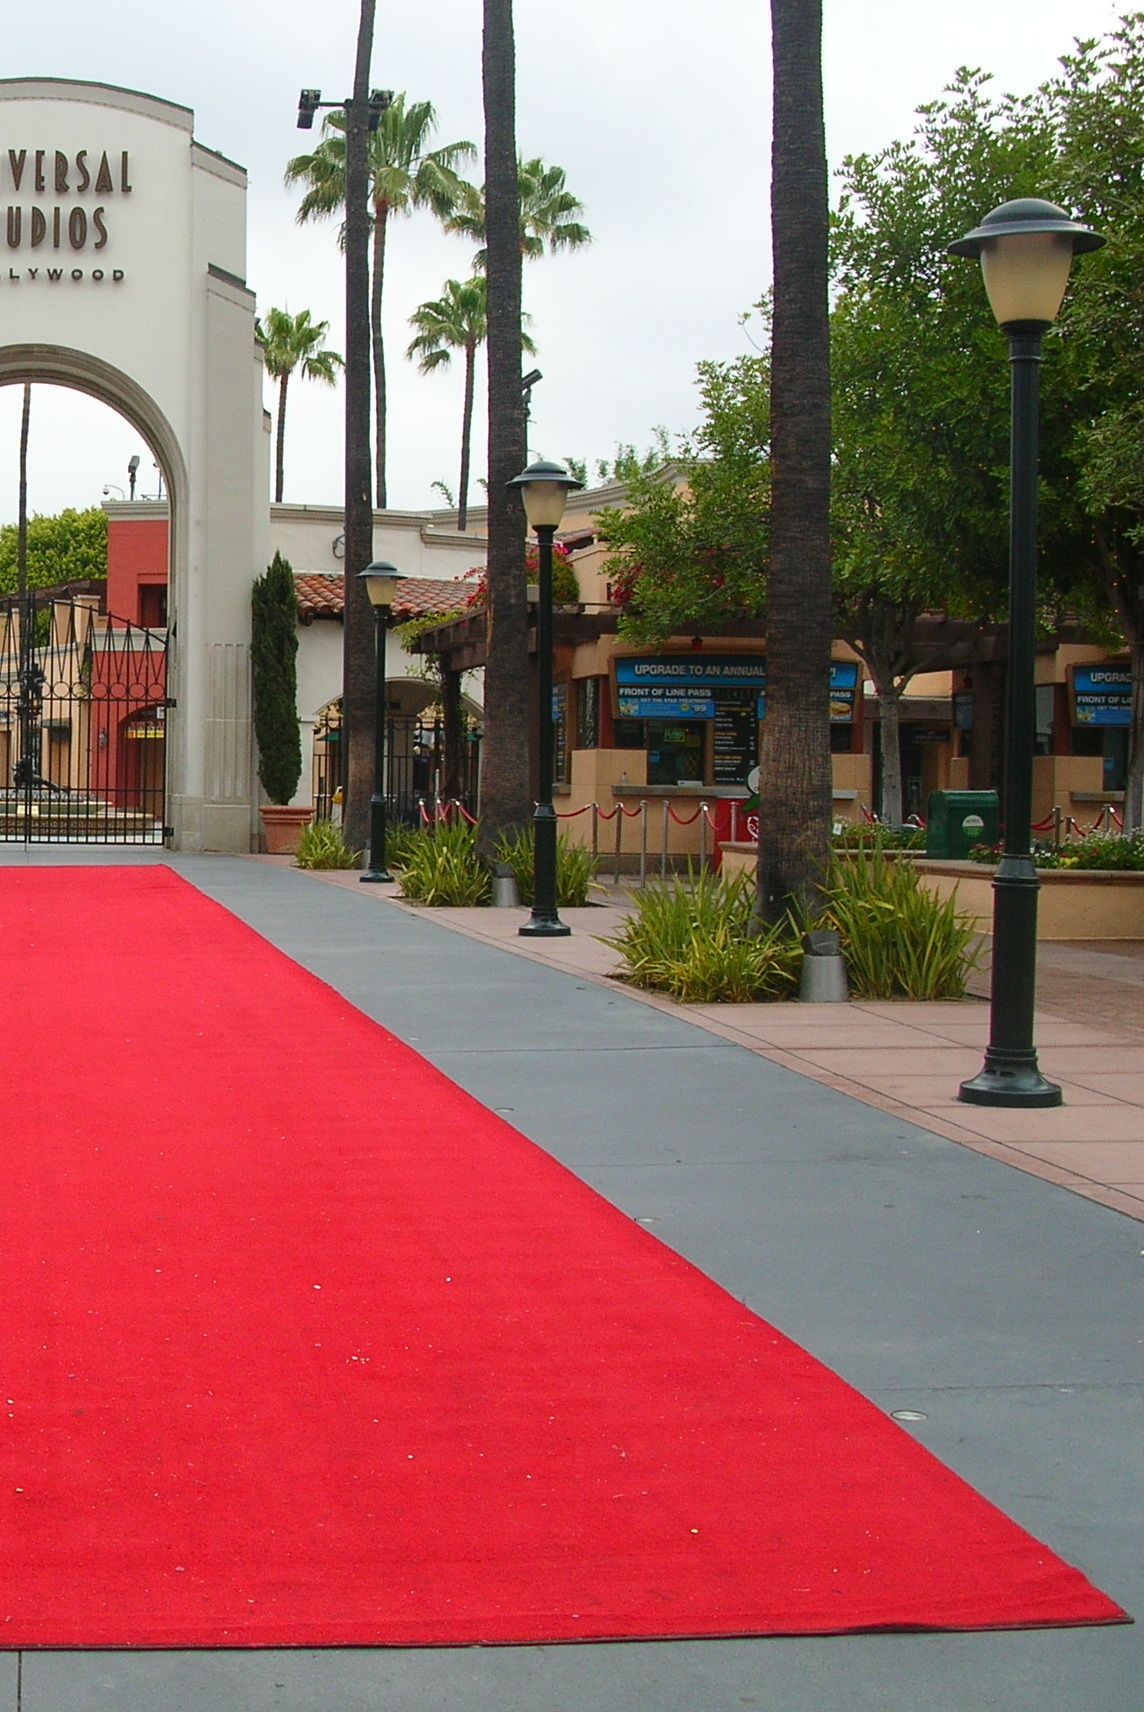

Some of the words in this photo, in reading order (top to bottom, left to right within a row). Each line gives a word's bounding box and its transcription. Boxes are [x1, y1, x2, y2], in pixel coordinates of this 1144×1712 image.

[634, 665, 686, 675] UPGRADE
[689, 665, 704, 675] TO
[706, 666, 720, 676] AN
[723, 666, 765, 676] ANNUAL
[619, 688, 649, 696] FRONT
[688, 689, 712, 697] PASS
[1077, 695, 1106, 703] FRONT
